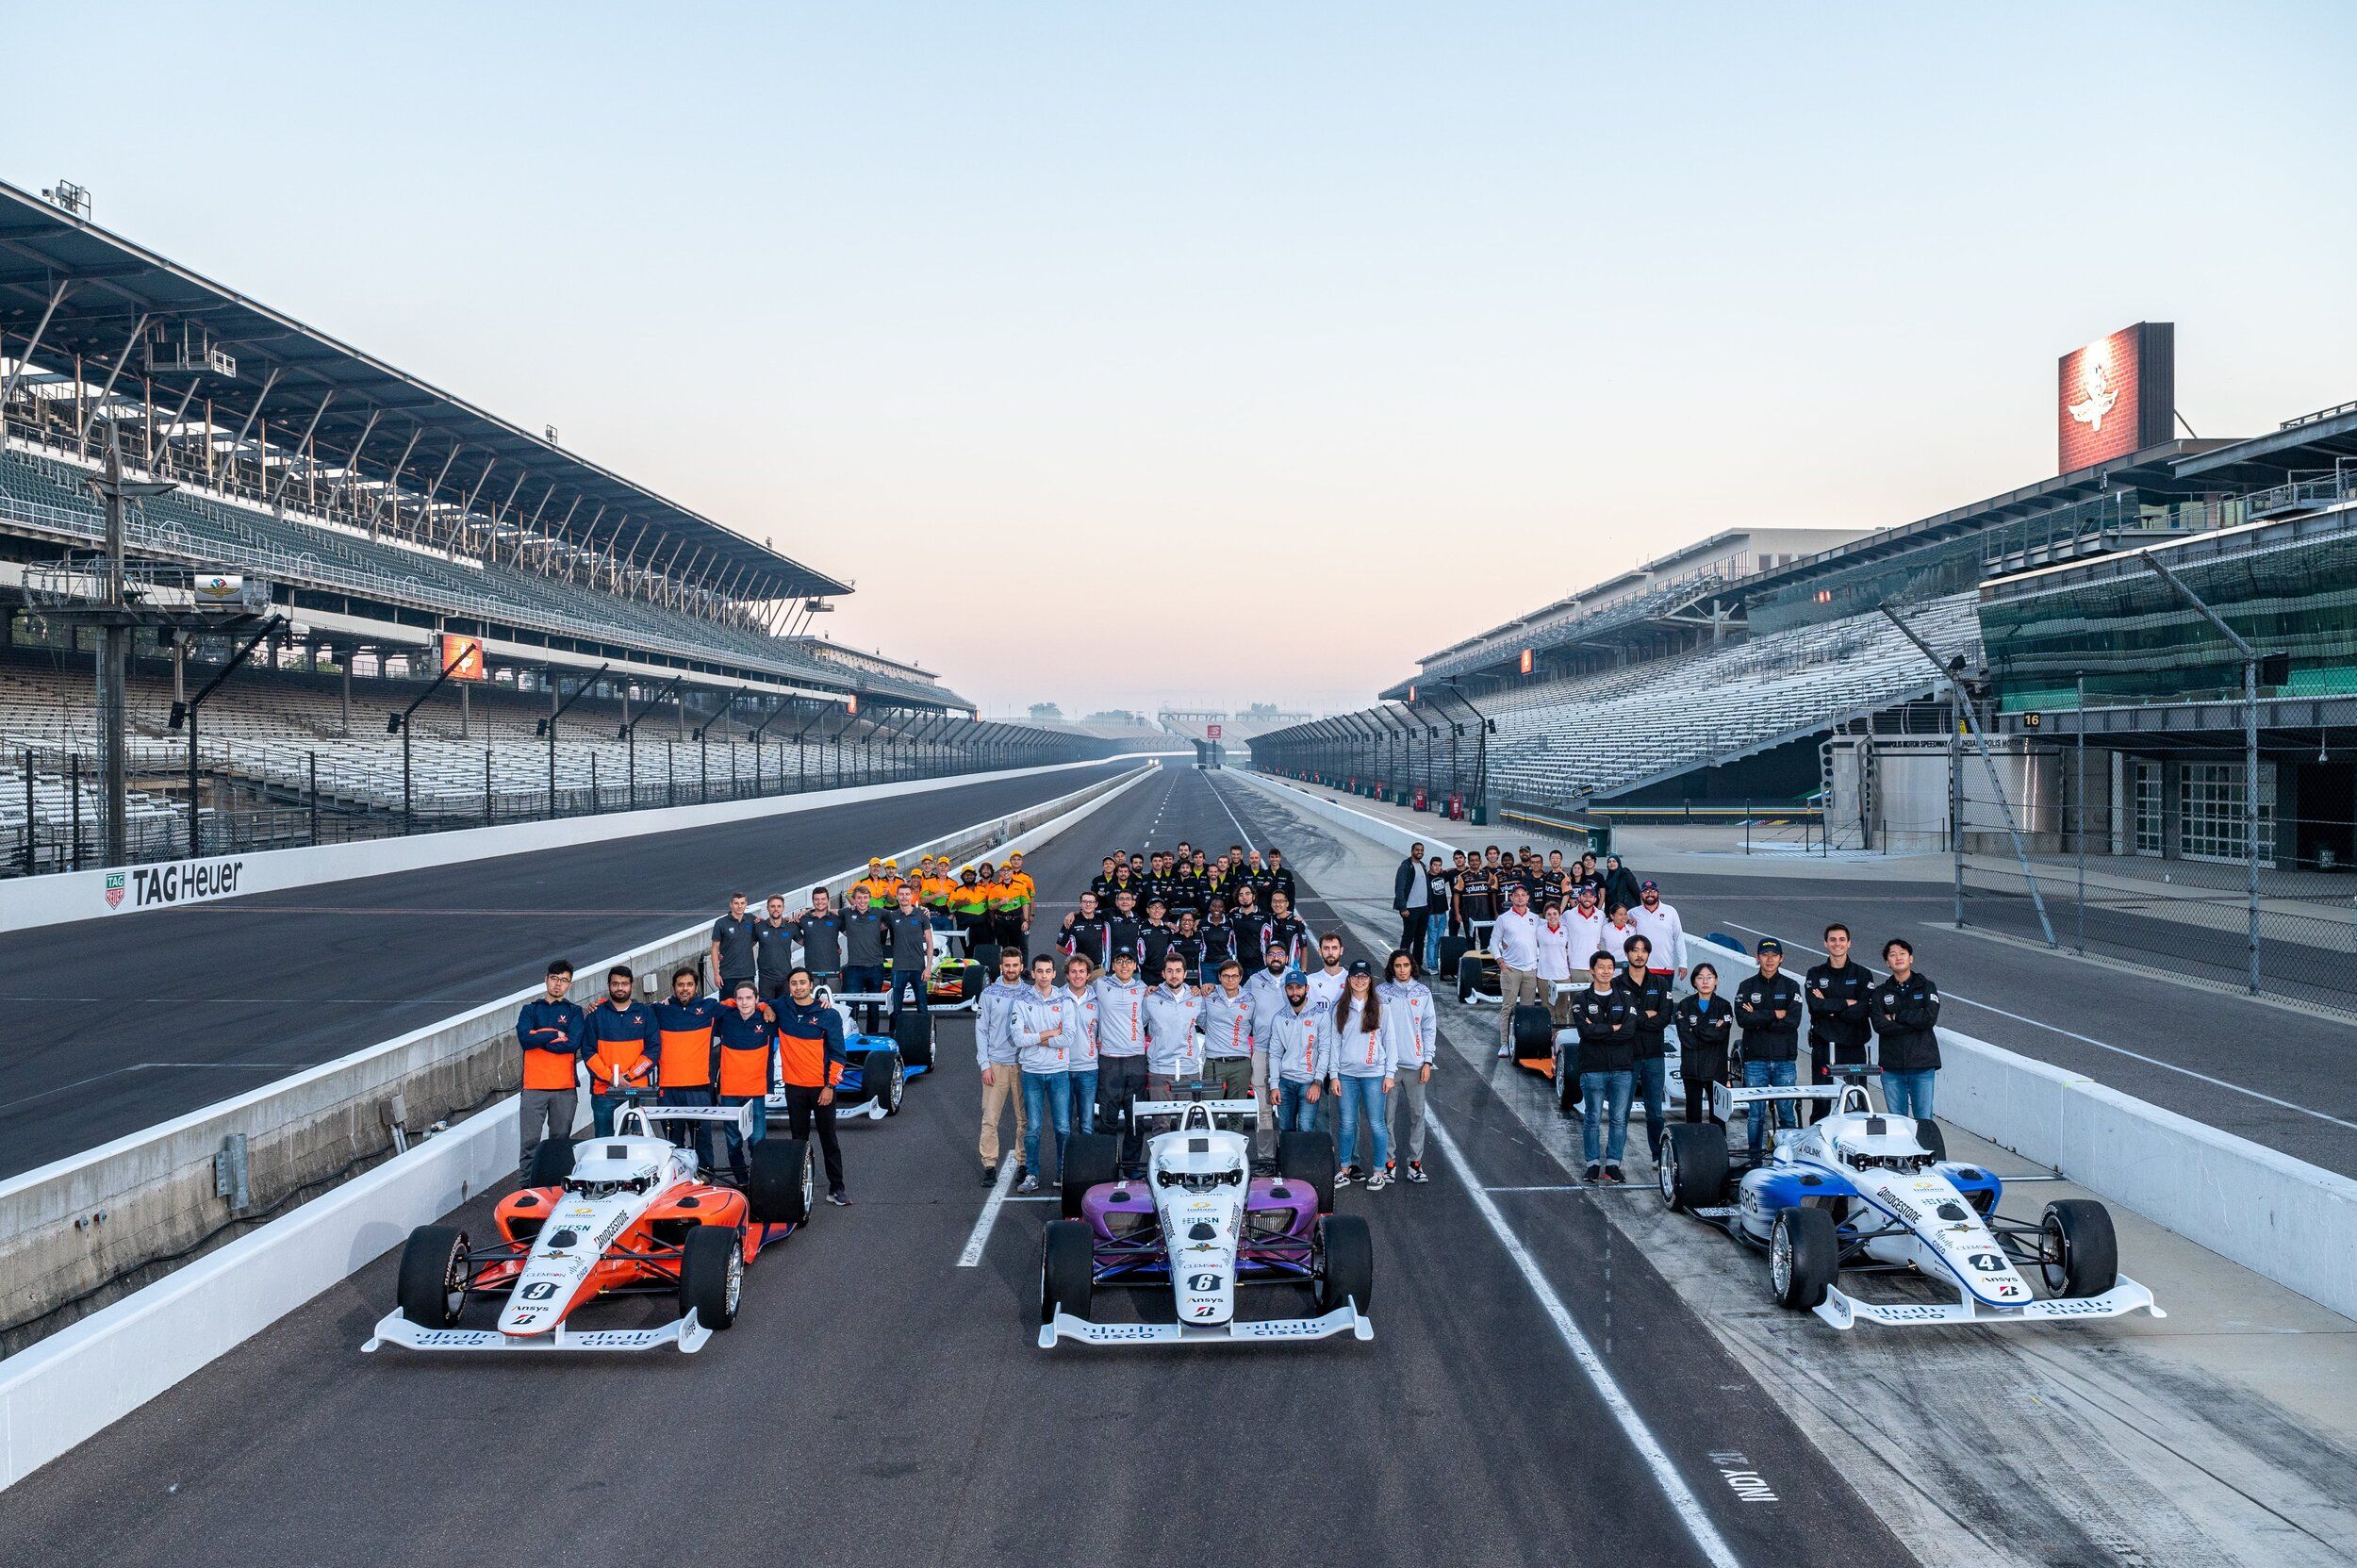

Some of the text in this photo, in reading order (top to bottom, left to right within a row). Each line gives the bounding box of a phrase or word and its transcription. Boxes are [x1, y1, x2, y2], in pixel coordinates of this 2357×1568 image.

[2024, 715, 2039, 726] 16
[107, 876, 124, 887] TAG
[133, 861, 243, 906] TAG Heuer
[1876, 1186, 1923, 1225] BRIDGESTONE
[592, 1209, 631, 1250] BRIDGESTONE
[1978, 1255, 1995, 1271] 4
[527, 1282, 552, 1299] 9
[1195, 1274, 1214, 1292] 6
